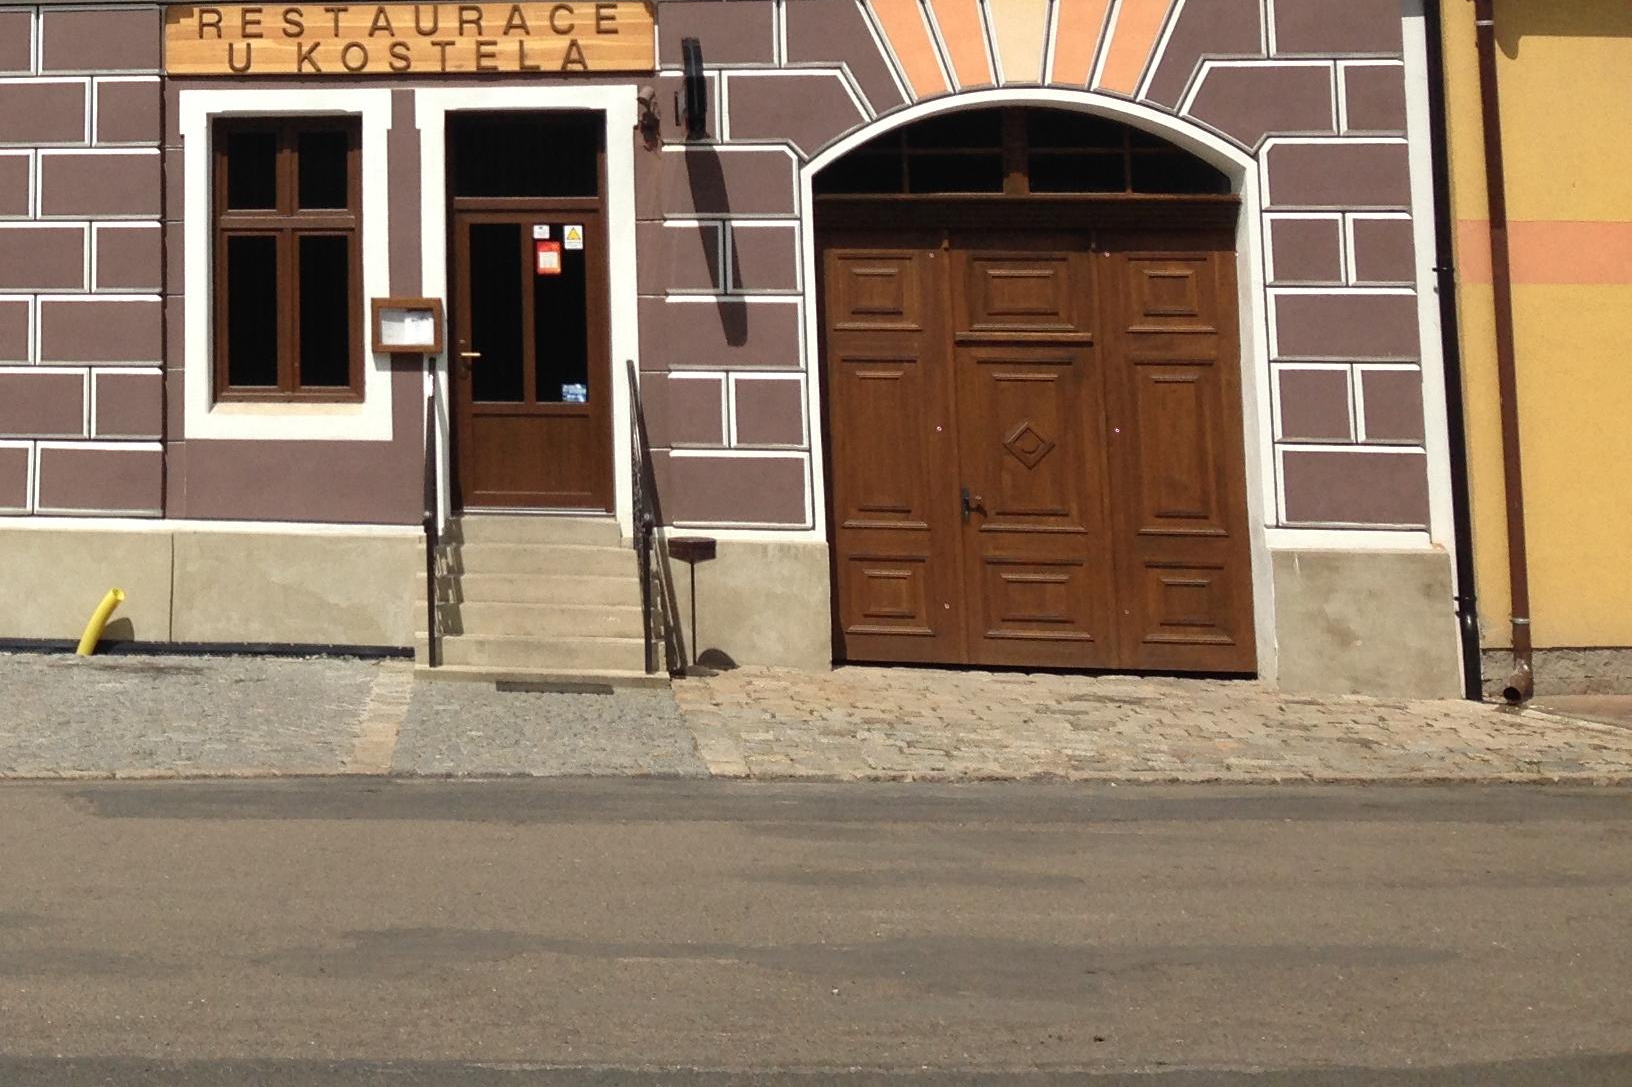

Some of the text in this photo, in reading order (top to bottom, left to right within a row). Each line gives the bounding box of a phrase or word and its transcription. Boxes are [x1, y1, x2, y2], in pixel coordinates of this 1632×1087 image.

[198, 4, 619, 39] RESTAURACE
[228, 39, 590, 73] U KOSTELA
